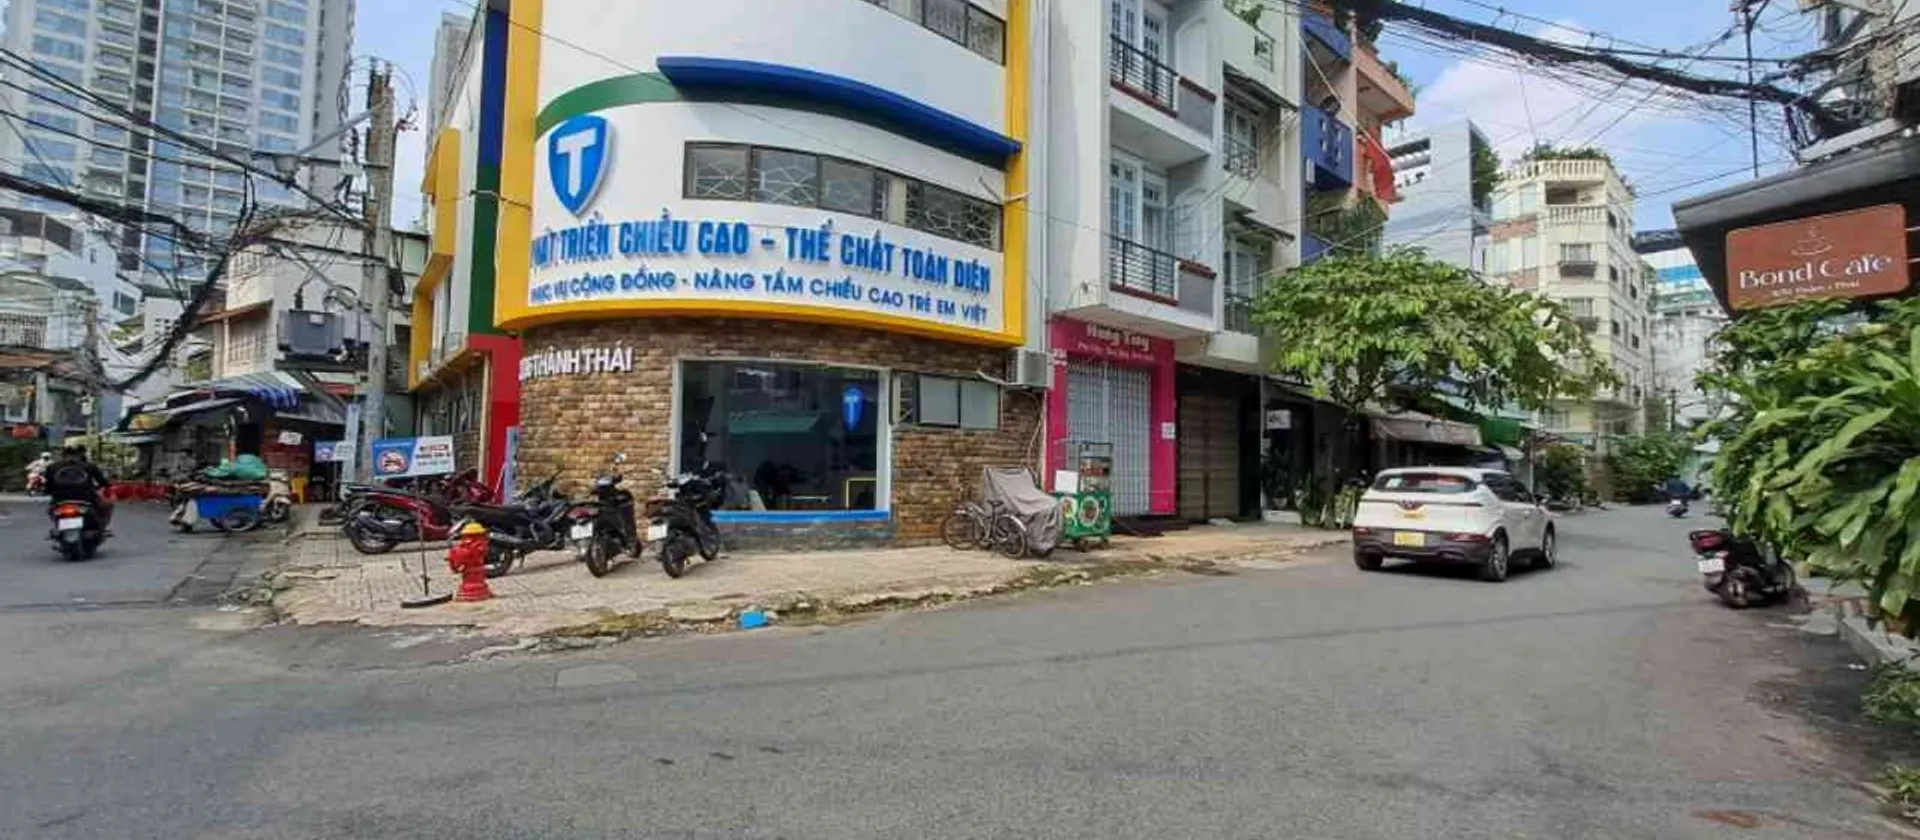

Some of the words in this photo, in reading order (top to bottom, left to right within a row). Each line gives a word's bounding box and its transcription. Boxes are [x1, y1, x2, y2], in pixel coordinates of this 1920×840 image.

[698, 220, 749, 256] CAO
[785, 218, 832, 261] THỂ
[840, 229, 896, 273] CHẤT
[902, 246, 948, 284] TOÀN
[954, 258, 991, 296] DIỆN
[1739, 261, 1813, 290] Bond
[570, 273, 615, 297] CỘNG
[621, 264, 676, 291] ĐỒNG
[694, 267, 755, 290] NÂNG
[868, 287, 904, 308] CAO
[937, 300, 956, 316] EM
[961, 302, 987, 325] VIỆT
[582, 340, 633, 374] THÁI
